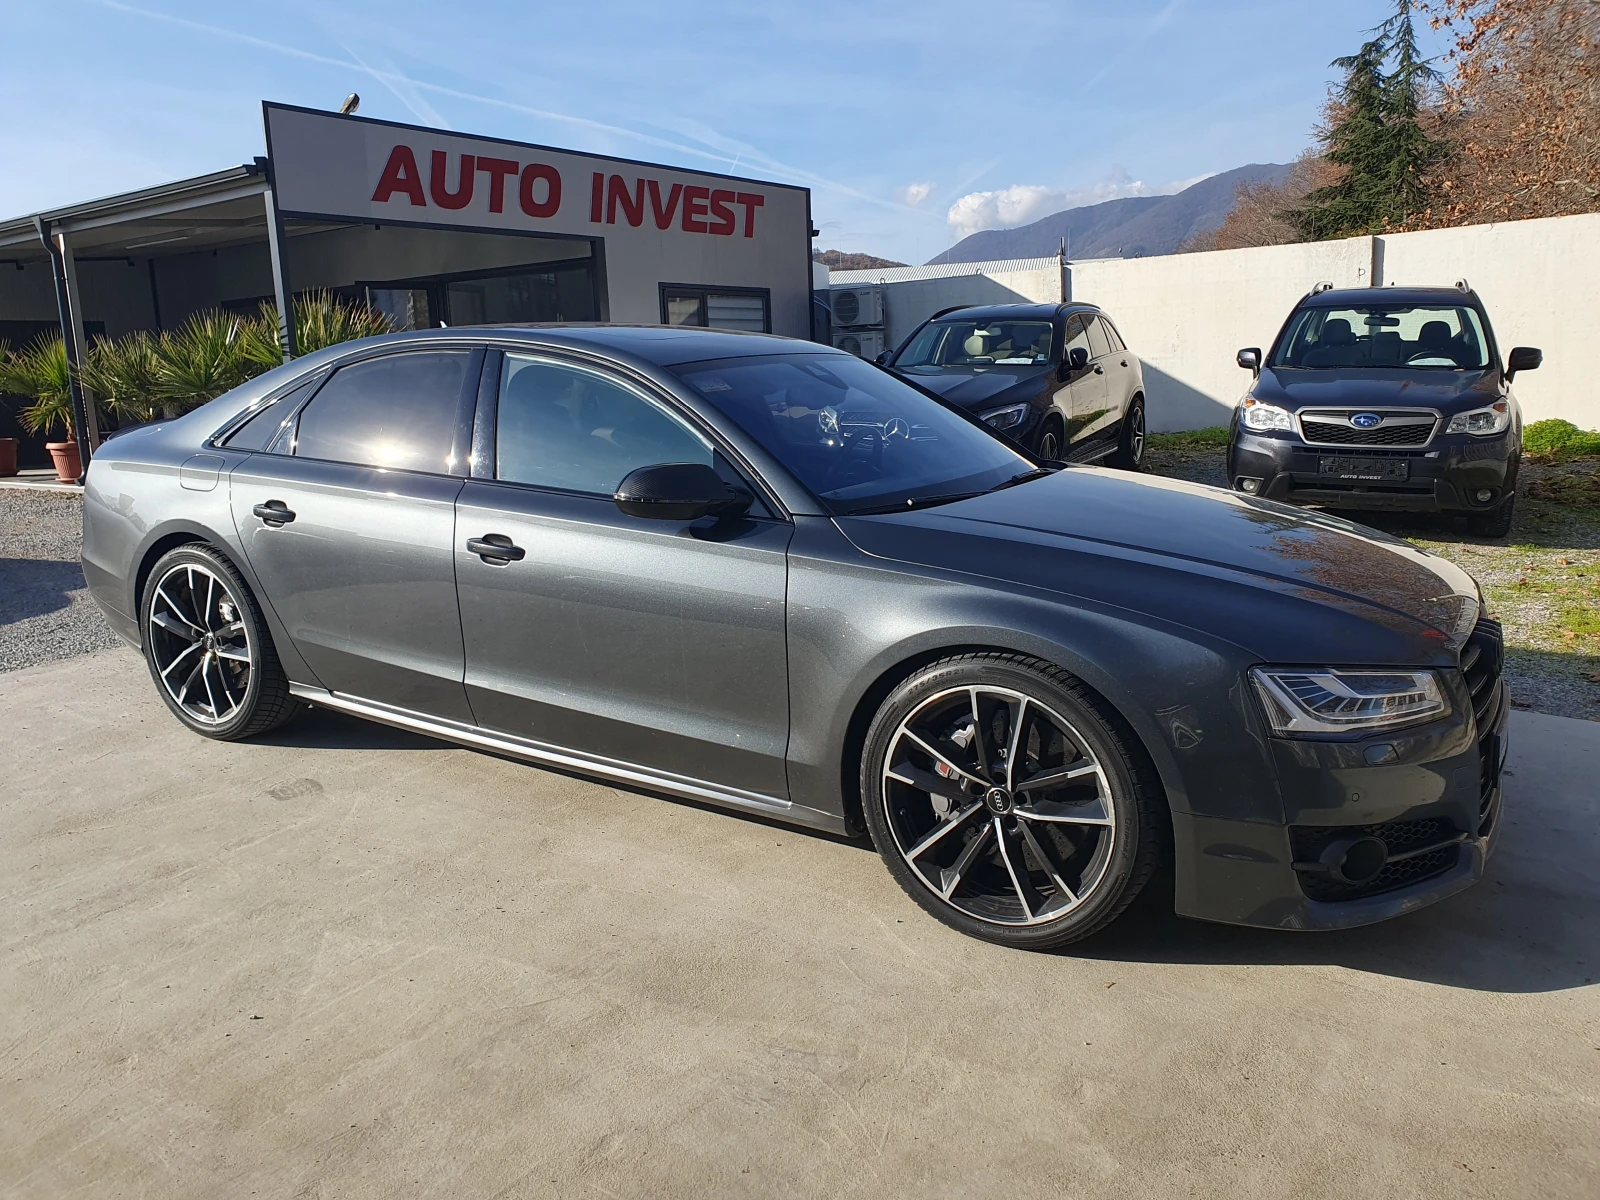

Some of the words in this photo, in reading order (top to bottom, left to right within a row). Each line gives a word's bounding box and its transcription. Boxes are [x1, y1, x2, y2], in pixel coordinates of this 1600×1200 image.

[372, 145, 562, 218] AUTO
[590, 172, 765, 238] INVEST
[908, 668, 965, 695] 275/35R21
